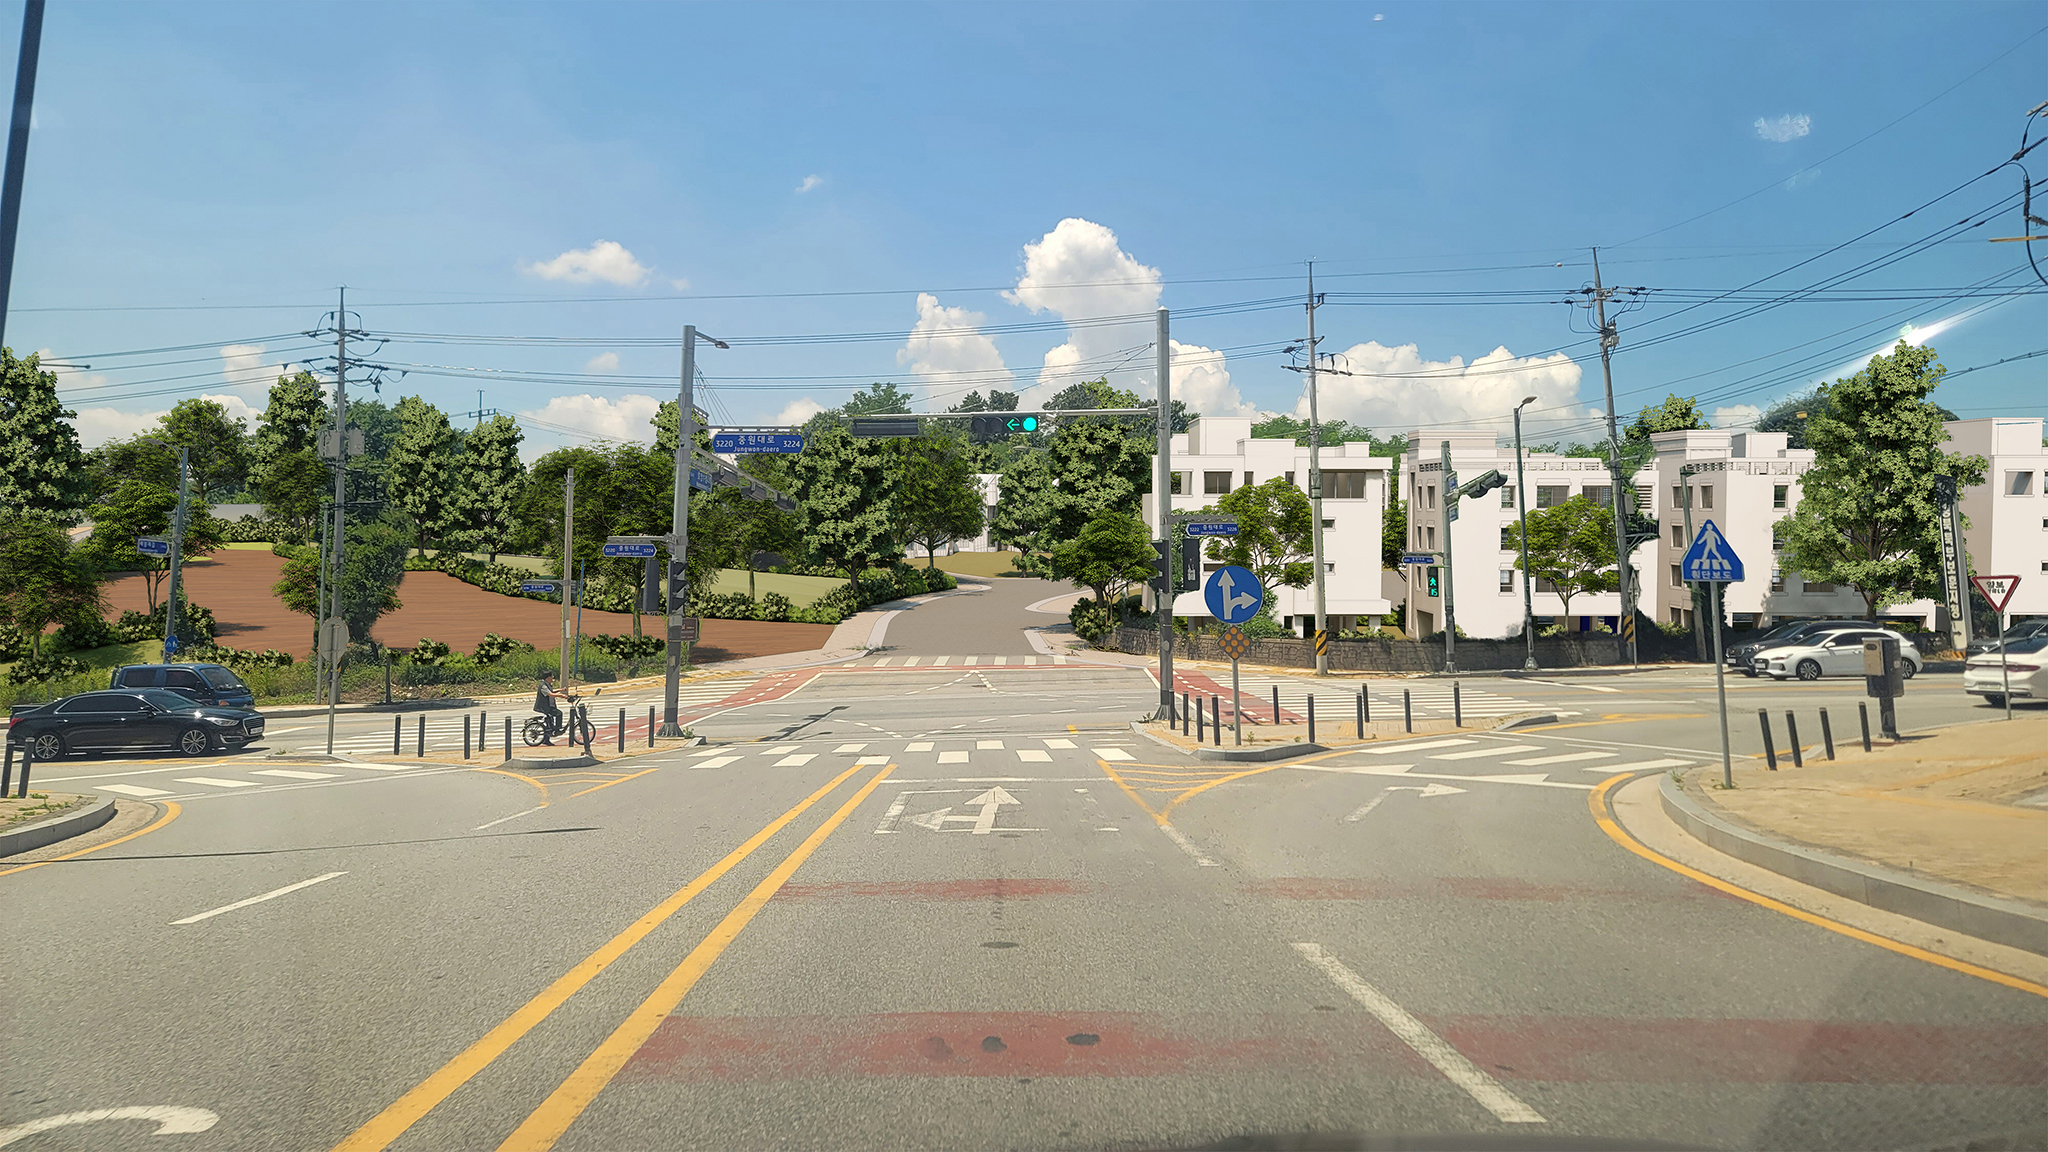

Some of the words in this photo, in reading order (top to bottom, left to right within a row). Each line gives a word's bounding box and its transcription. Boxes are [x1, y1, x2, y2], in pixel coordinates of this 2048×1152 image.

[715, 440, 733, 448] 3220
[738, 435, 775, 446] 중원대로
[783, 440, 801, 448] 3224
[1691, 570, 1732, 580] 횡단보도
[1986, 581, 2005, 589] 양보
